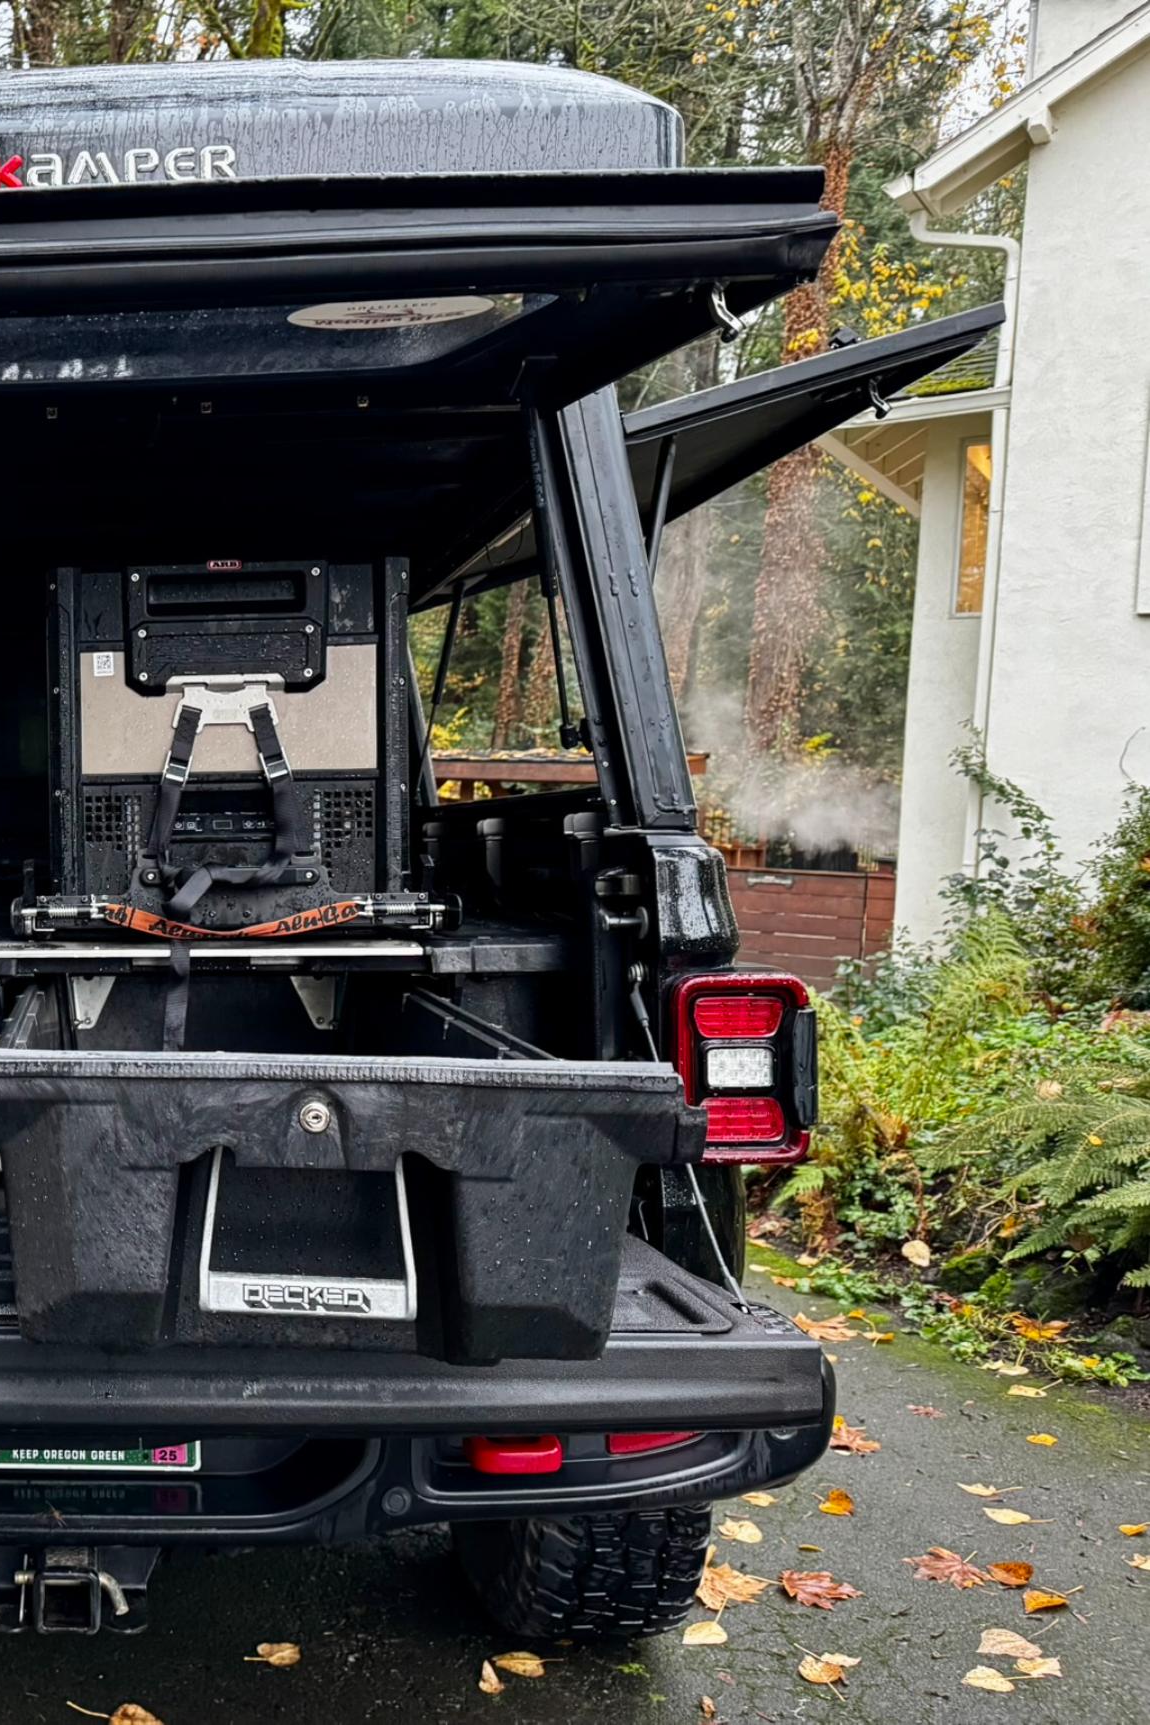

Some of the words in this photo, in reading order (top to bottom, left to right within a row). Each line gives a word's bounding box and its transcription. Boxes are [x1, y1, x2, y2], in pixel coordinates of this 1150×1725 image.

[243, 1283, 371, 1313] DECKED
[12, 1449, 39, 1460] KEEP
[43, 1449, 86, 1460] OREGON
[90, 1450, 126, 1461] GREEN
[158, 1449, 178, 1461] 25
